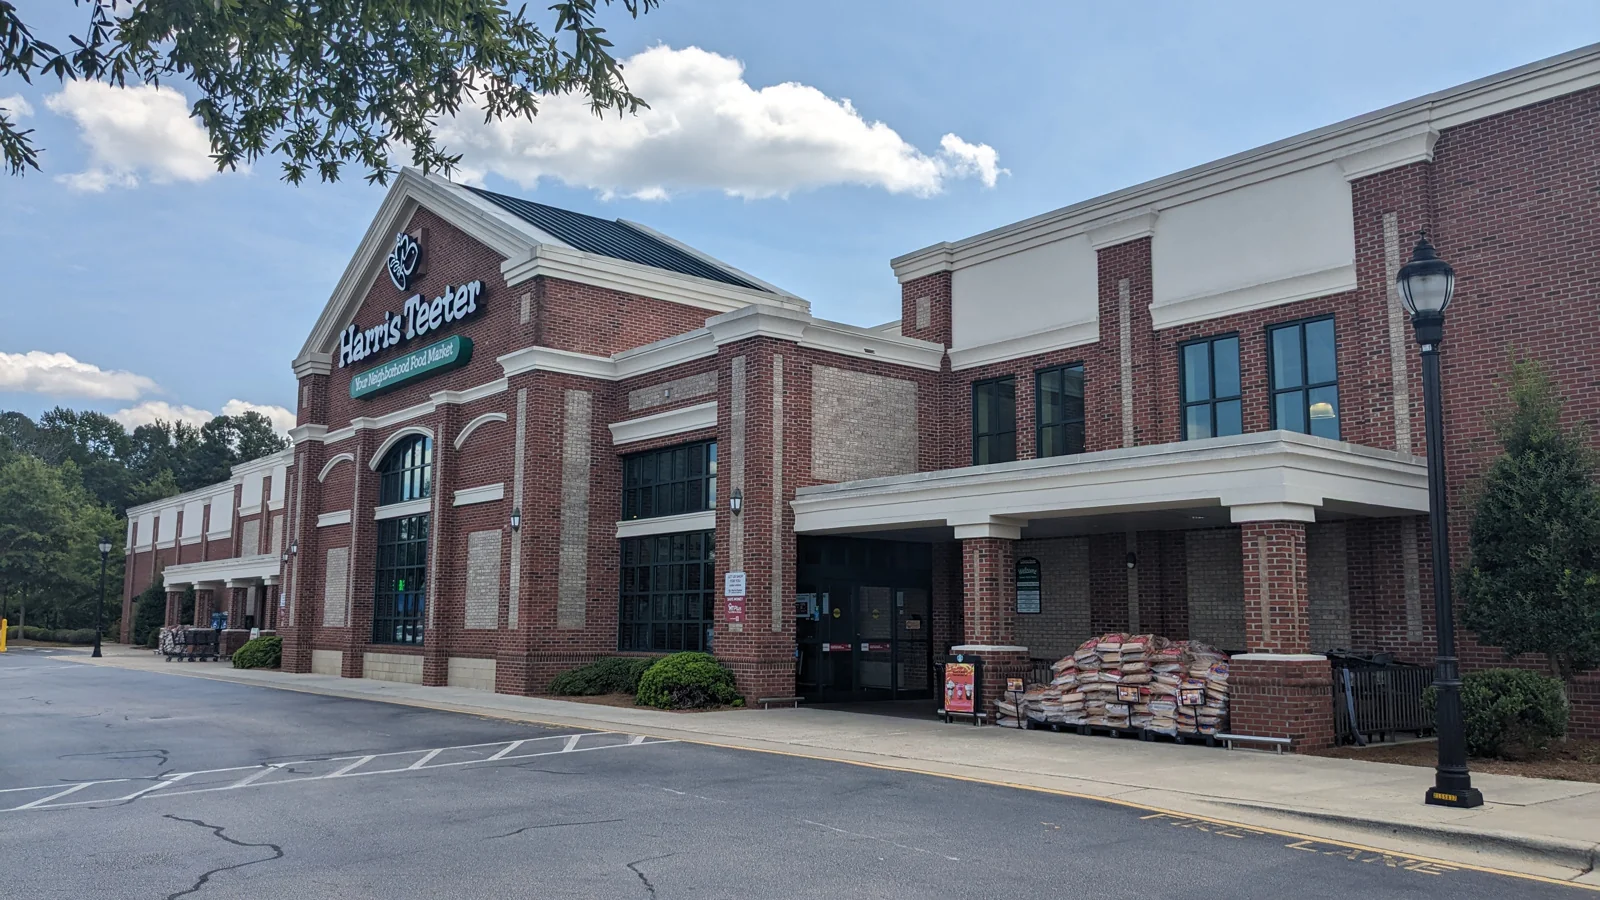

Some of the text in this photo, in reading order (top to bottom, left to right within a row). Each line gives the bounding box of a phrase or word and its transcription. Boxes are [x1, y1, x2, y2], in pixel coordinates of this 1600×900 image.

[339, 280, 481, 368] Harris Teeter
[355, 342, 454, 391] Your Neighborhood Food Market
[1139, 813, 1460, 876] FIRE LANE
